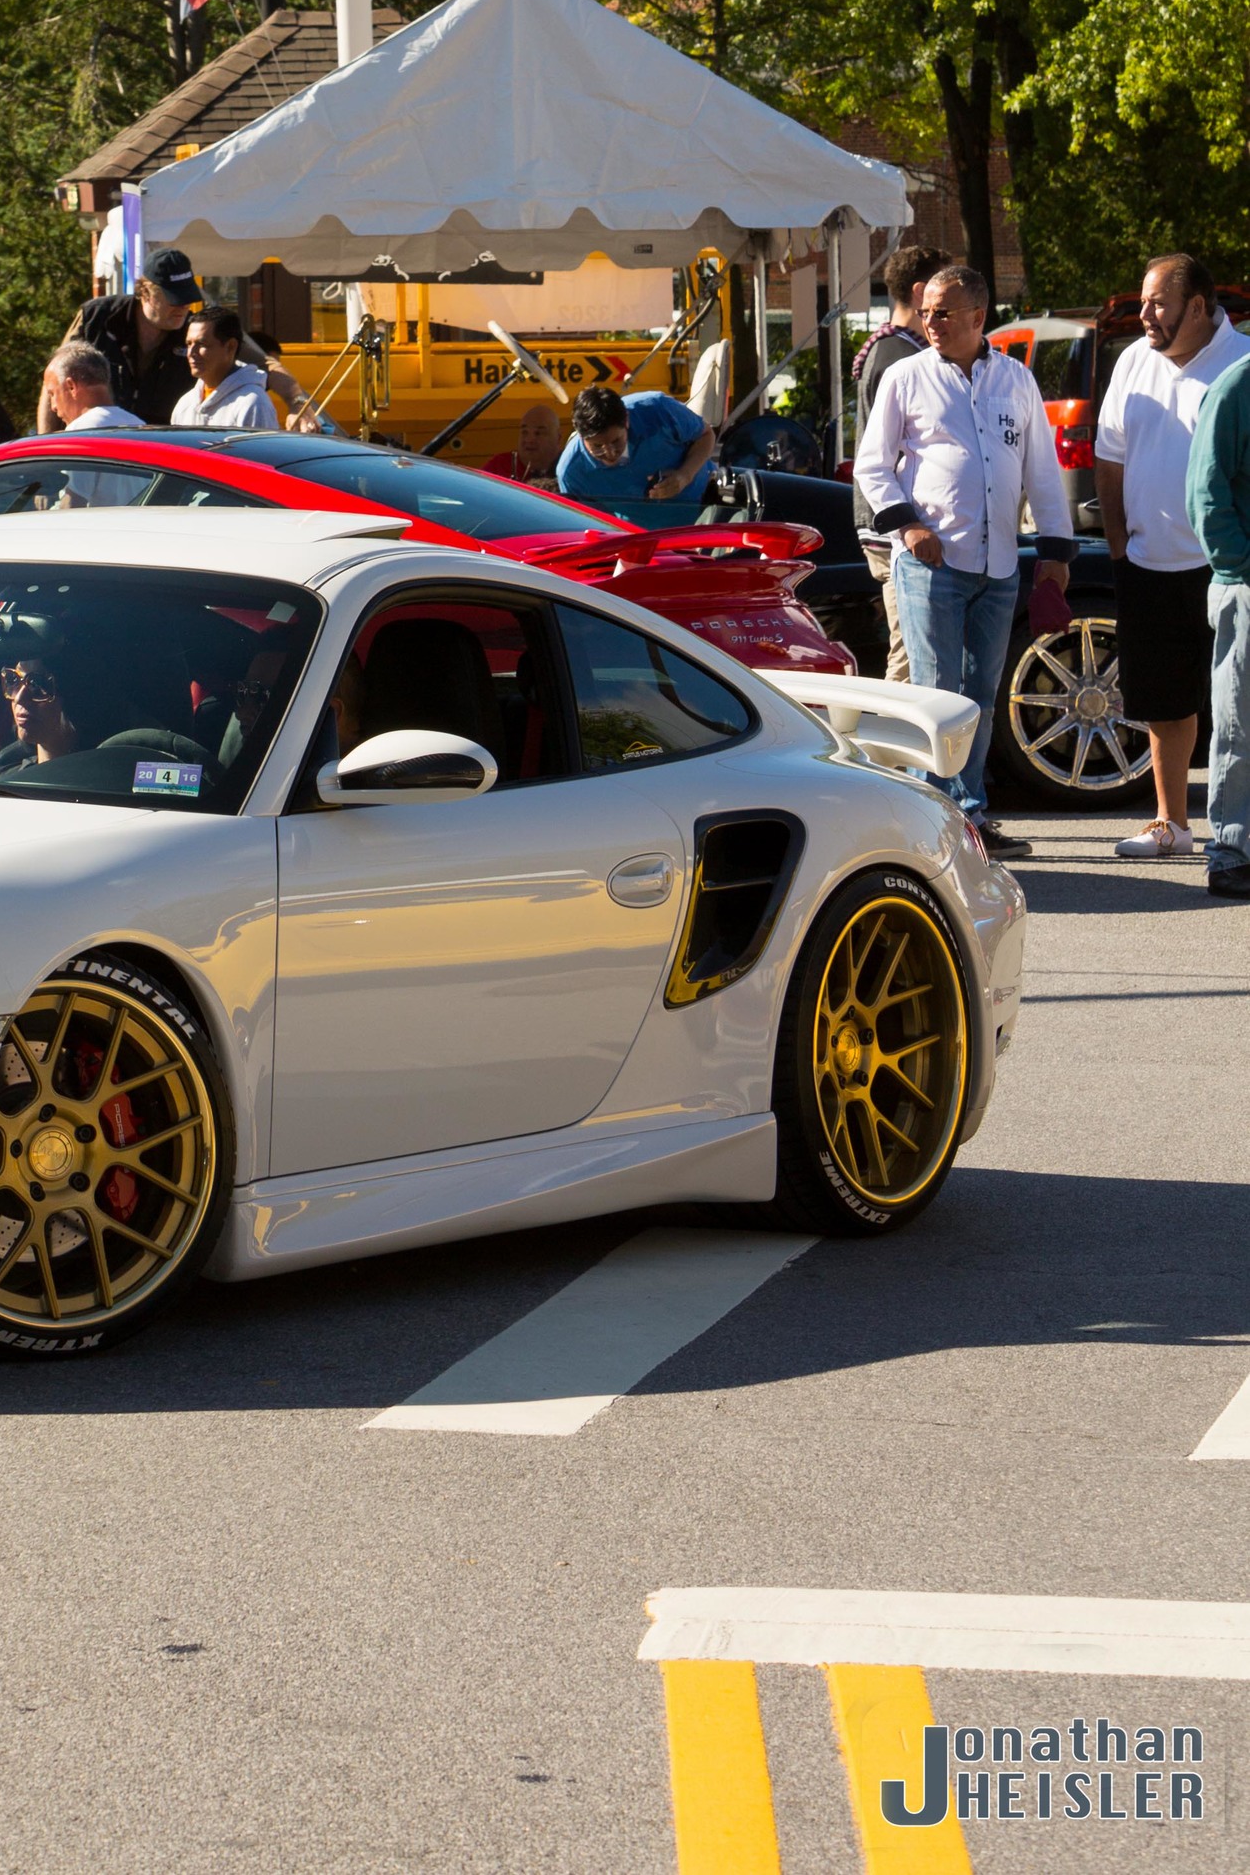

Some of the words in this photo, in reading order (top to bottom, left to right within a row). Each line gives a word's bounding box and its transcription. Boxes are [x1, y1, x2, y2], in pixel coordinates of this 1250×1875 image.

[465, 358, 583, 384] Hatte
[998, 414, 1015, 428] Hs
[691, 618, 794, 630] PORSCHE
[731, 635, 748, 644] 911
[775, 633, 784, 643] S
[138, 770, 153, 779] 20
[162, 771, 171, 783] 4
[183, 774, 198, 782] 16
[56, 959, 198, 1040] TINENTAL
[114, 1103, 126, 1147] PORS
[819, 1151, 891, 1224] EXTREME
